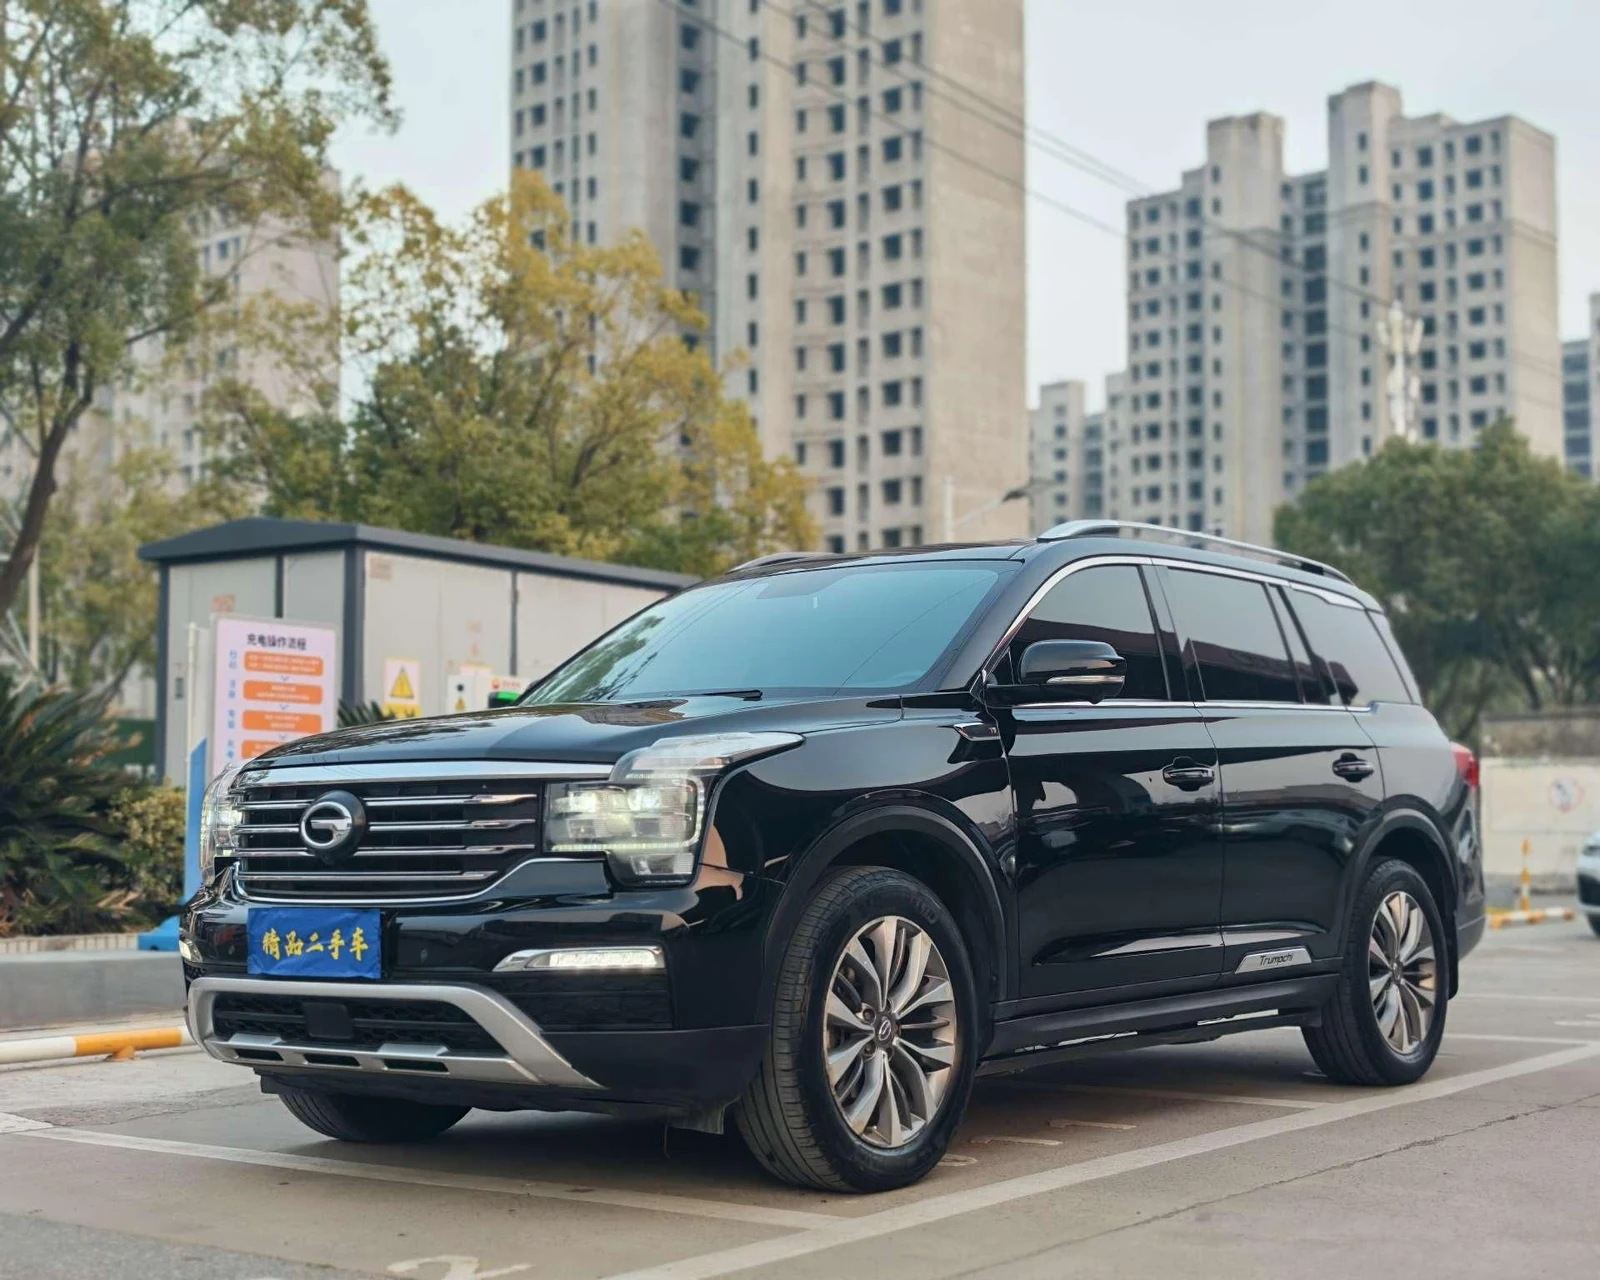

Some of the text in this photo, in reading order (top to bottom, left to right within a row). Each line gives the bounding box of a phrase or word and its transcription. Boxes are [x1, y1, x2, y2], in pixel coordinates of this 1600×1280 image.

[247, 634, 307, 650] 充电操作流程
[262, 927, 369, 961] 精品二手车
